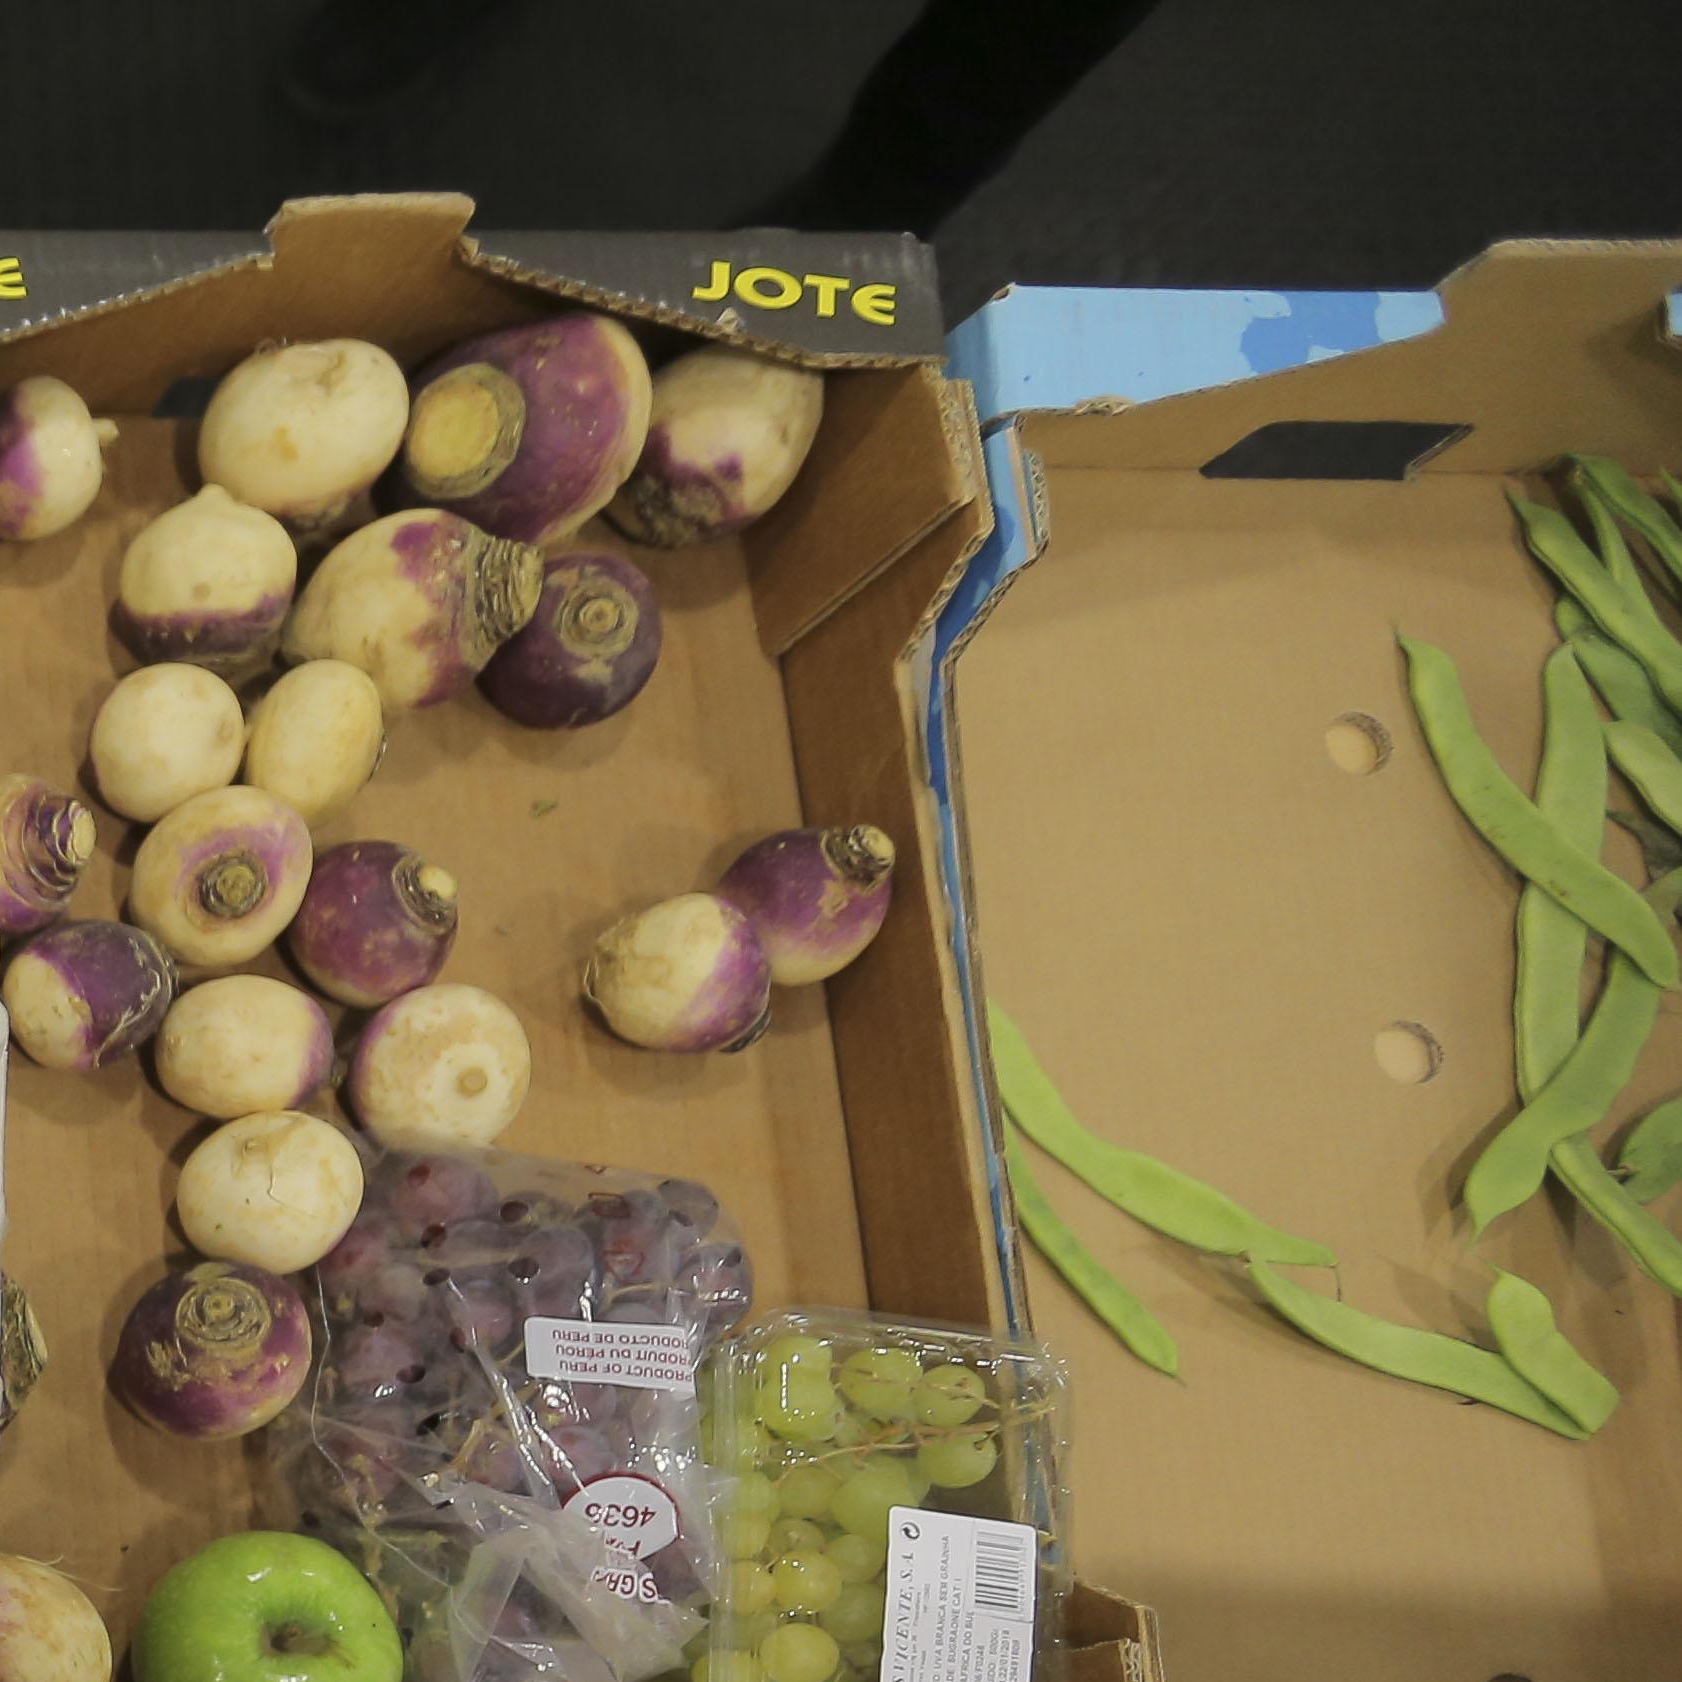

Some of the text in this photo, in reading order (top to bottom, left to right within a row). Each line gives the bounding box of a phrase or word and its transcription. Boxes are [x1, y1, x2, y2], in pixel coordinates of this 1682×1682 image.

[693, 260, 897, 326] JOTE
[551, 1329, 615, 1344] DE PERU
[609, 1347, 632, 1359] DU
[558, 1359, 693, 1382] PRODUCT OF PERU
[933, 1534, 950, 1670] UVA BRANCA SEM GRAINHA
[892, 1586, 914, 1671] VICENTE,
[965, 1610, 975, 1629] SUL
[963, 1630, 972, 1646] DO
